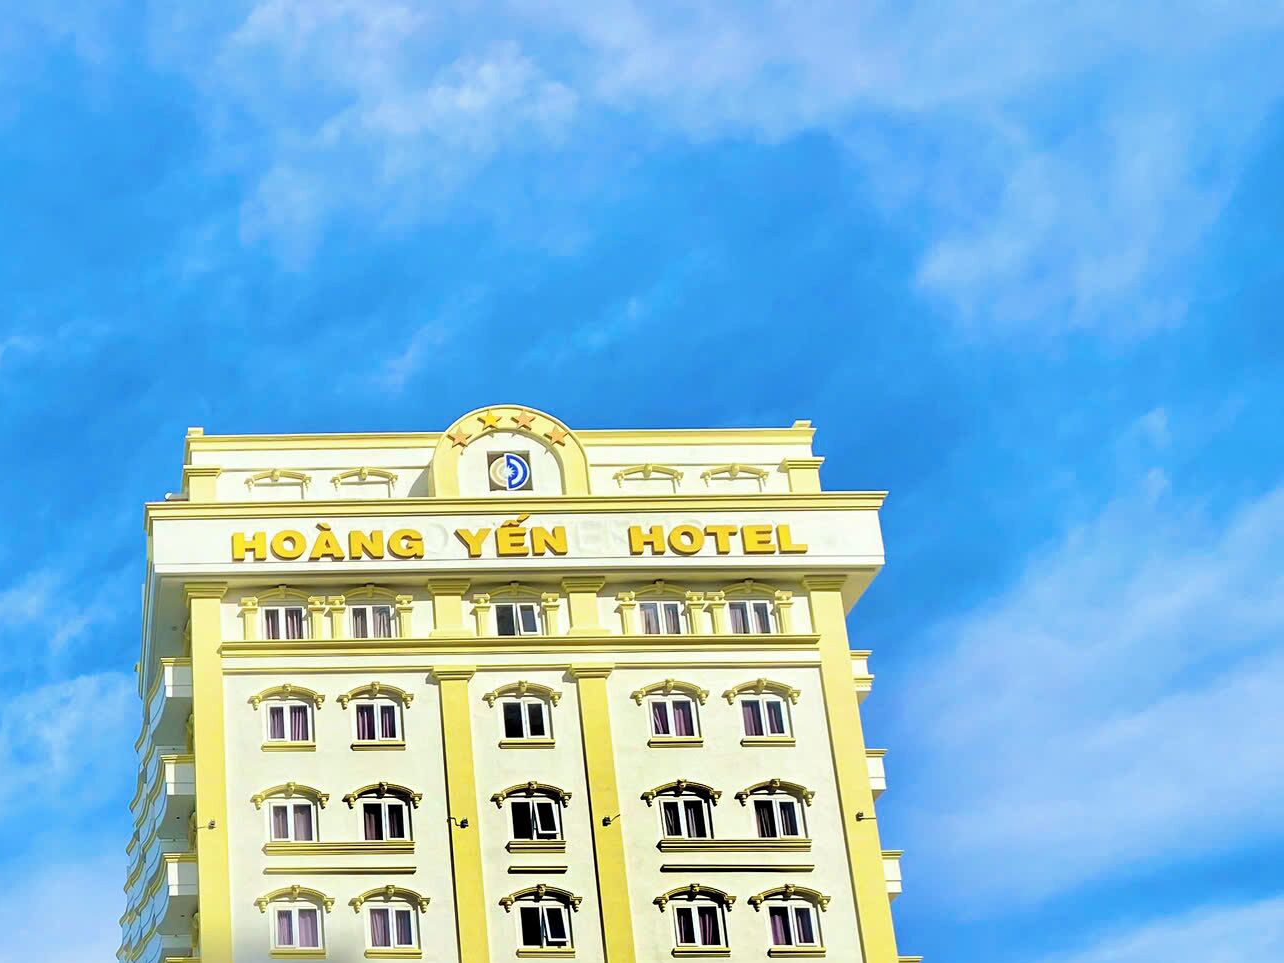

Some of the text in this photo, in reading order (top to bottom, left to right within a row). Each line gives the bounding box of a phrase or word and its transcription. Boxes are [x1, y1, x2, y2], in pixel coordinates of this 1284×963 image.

[231, 513, 808, 561] HOÀNG YẾN HOTEL
